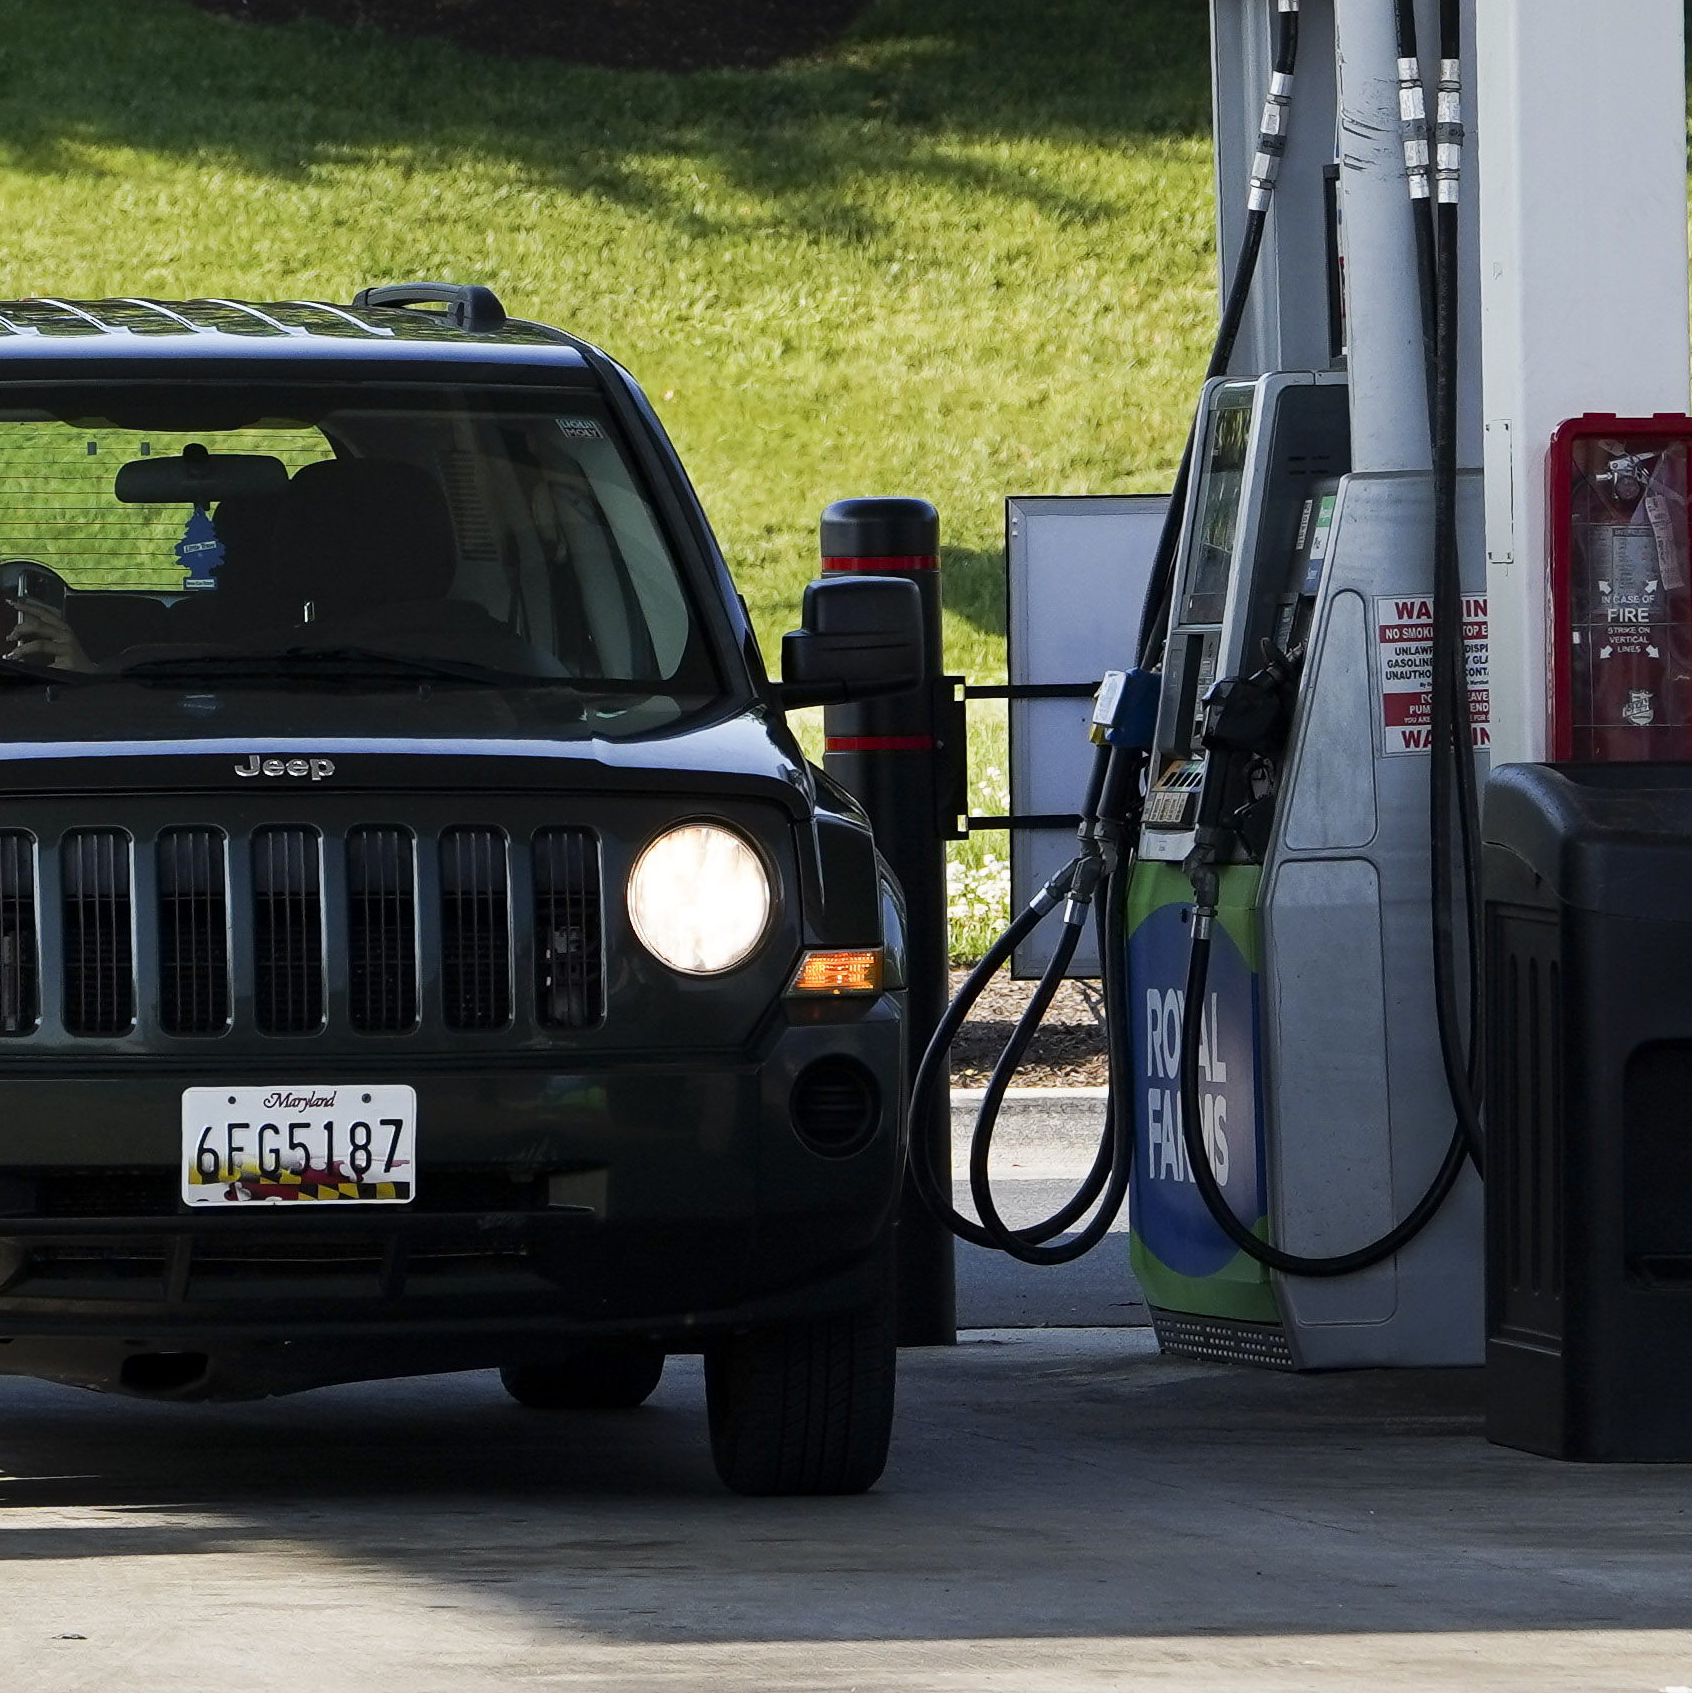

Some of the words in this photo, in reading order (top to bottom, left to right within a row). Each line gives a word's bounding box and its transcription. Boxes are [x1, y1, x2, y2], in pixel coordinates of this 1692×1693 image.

[566, 428, 598, 437] MOLY
[1601, 595, 1611, 604] IN
[1613, 595, 1640, 604] CASE
[1642, 595, 1656, 604] OF
[1395, 599, 1488, 620] WAIN
[1607, 608, 1650, 623] FIRE
[1385, 628, 1400, 640] NO
[1402, 627, 1434, 639] SMOKI
[1607, 626, 1637, 635] STRIKE
[1639, 626, 1651, 634] ON
[1609, 635, 1649, 644] VERTICAL
[1617, 645, 1642, 653] LINES
[1385, 669, 1432, 681] UNAUTHO
[1409, 704, 1432, 714] PUM
[1401, 727, 1490, 749] WAIN
[234, 754, 335, 780] Jeep
[1147, 988, 1227, 1083] ROAL
[263, 1091, 337, 1113] Maryland
[196, 1118, 404, 1178] 6FG5187
